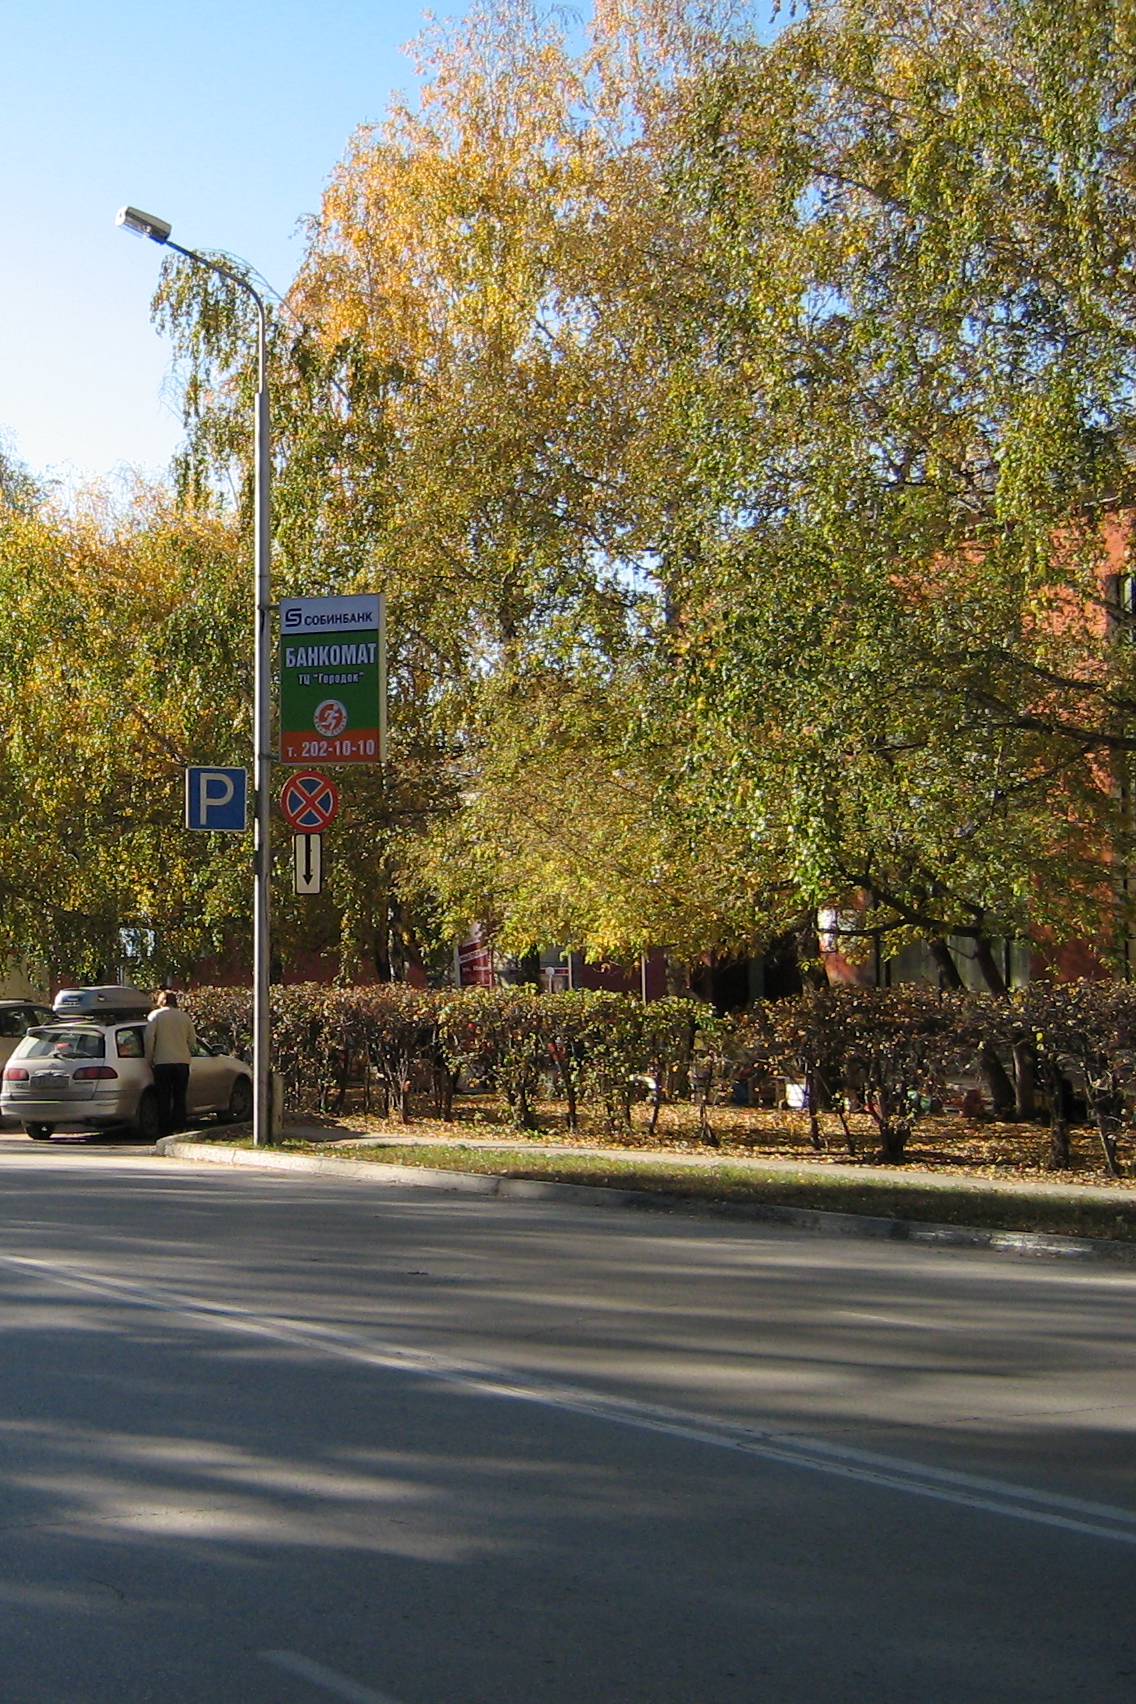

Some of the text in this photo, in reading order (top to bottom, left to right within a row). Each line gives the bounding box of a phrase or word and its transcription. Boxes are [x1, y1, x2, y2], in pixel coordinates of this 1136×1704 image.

[304, 611, 373, 626] СОБИНБАНК
[285, 643, 377, 668] БАНКОМАТ
[298, 674, 311, 685] ТЦ
[301, 739, 375, 757] 202-10-10
[199, 773, 234, 825] P
